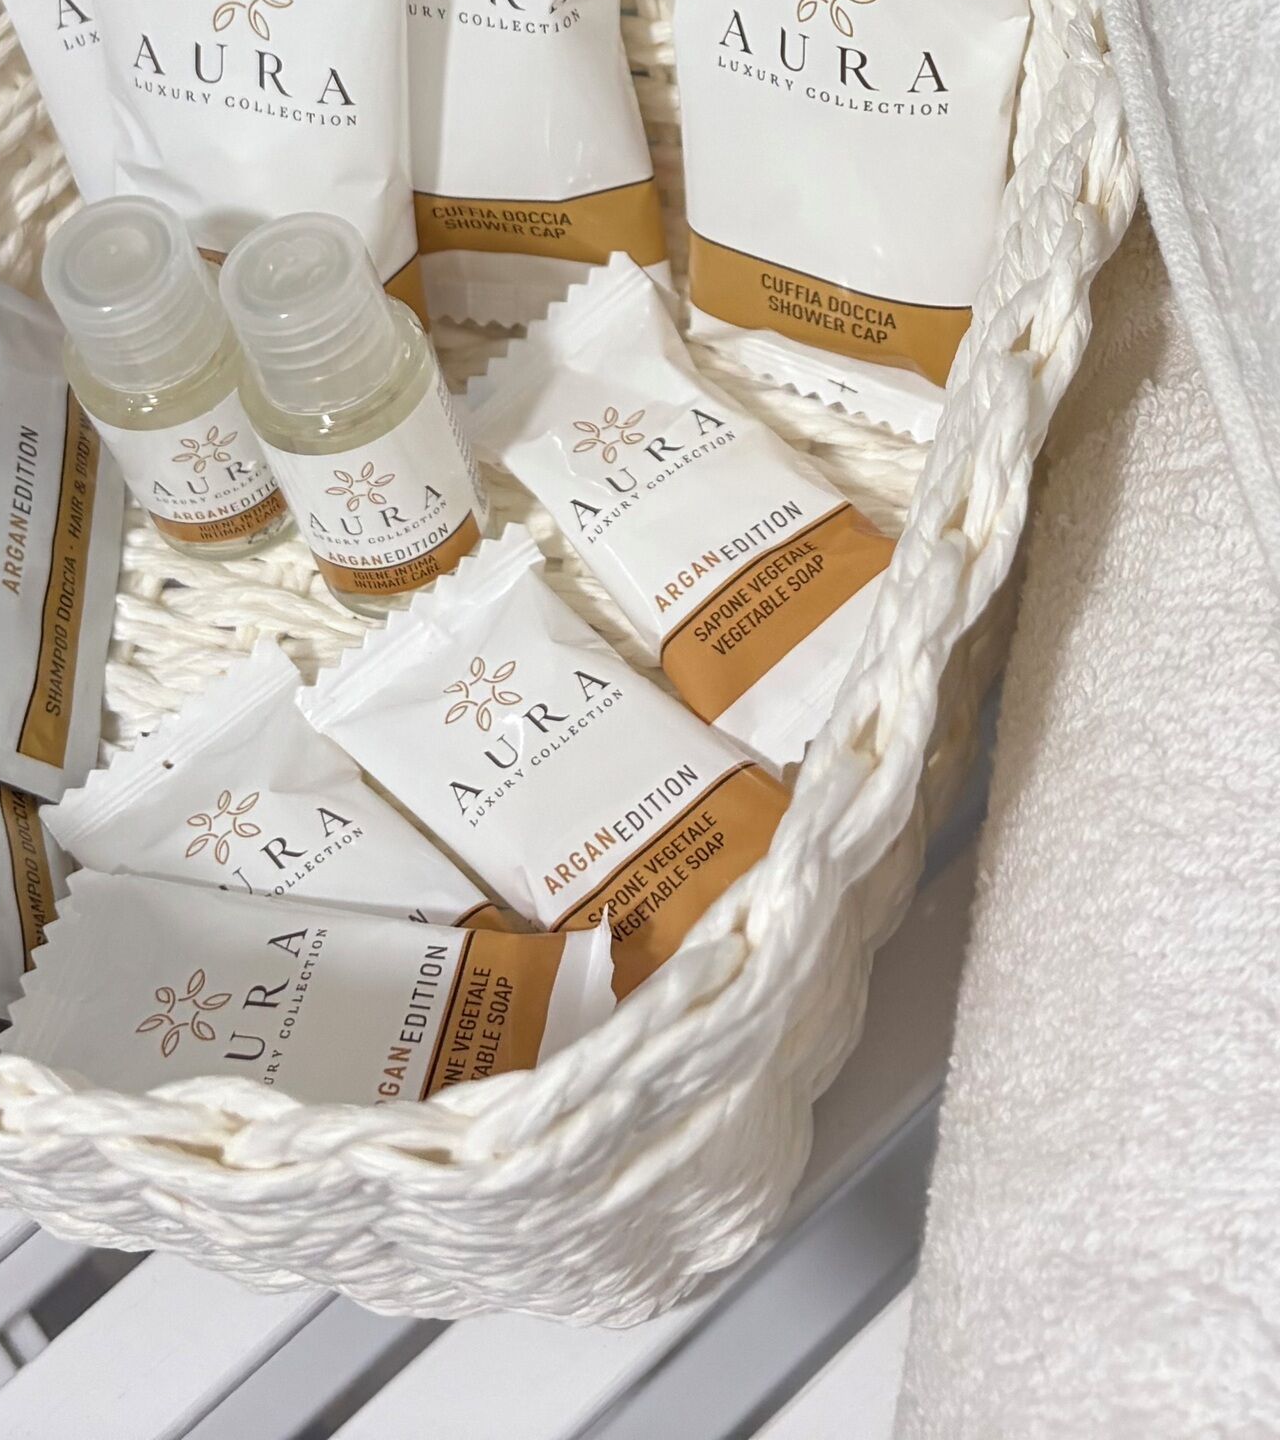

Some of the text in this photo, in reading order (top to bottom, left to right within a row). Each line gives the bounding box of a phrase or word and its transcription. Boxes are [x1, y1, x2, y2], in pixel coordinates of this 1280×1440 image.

[63, 30, 101, 51] LUX
[407, 3, 582, 35] URY COLLECTION
[718, 8, 950, 94] AURA
[133, 33, 356, 106] AURA
[134, 76, 358, 127] LUXURY COLLECTION
[717, 55, 950, 116] LUXURY COLLECTION
[431, 206, 573, 226] CUFFIA DOCCIA
[444, 218, 567, 240] SHOWER CAP
[761, 272, 897, 330] CUFFIA DOCCIA
[768, 295, 889, 345] SHOWER CAP
[73, 479, 87, 495] &
[75, 431, 91, 479] BODY
[152, 461, 253, 498] AUR
[214, 464, 268, 500] COLLEC
[569, 408, 727, 532] AURA
[586, 429, 738, 545] LUXURY COLLECTION
[1, 424, 40, 596] ARGANEDITION
[67, 496, 86, 540] HAIR
[172, 475, 279, 521] ARGANEDITIO
[309, 484, 443, 536] AURA
[367, 499, 448, 545] COLLECTION
[327, 522, 450, 567] ARGANEDITION
[352, 553, 438, 581] IGIENE INTIMA
[353, 562, 442, 591] INTIMATE CARE
[653, 500, 805, 613] ARGANEDITION
[55, 555, 78, 623] DOCCIA
[693, 540, 818, 643] SAPONE VEGETALE
[710, 553, 826, 657] VEGETABLE SOAP
[44, 622, 69, 718] SHAMPOO
[448, 669, 612, 816] AURA
[469, 688, 625, 829] LUXURY COLLECTION
[219, 806, 353, 896] RA
[265, 826, 365, 898] OLLECTION
[542, 763, 700, 896] ARGANEDITION
[643, 810, 718, 875] VEGETALE
[612, 831, 727, 943] VEGETABLE SOAP
[223, 927, 309, 1061] URA
[264, 927, 329, 1086] URY COLLECTION
[375, 944, 449, 1107] GANEDITION
[451, 965, 492, 1052] VEGETALE
[471, 974, 515, 1081] TABLE SOAP
